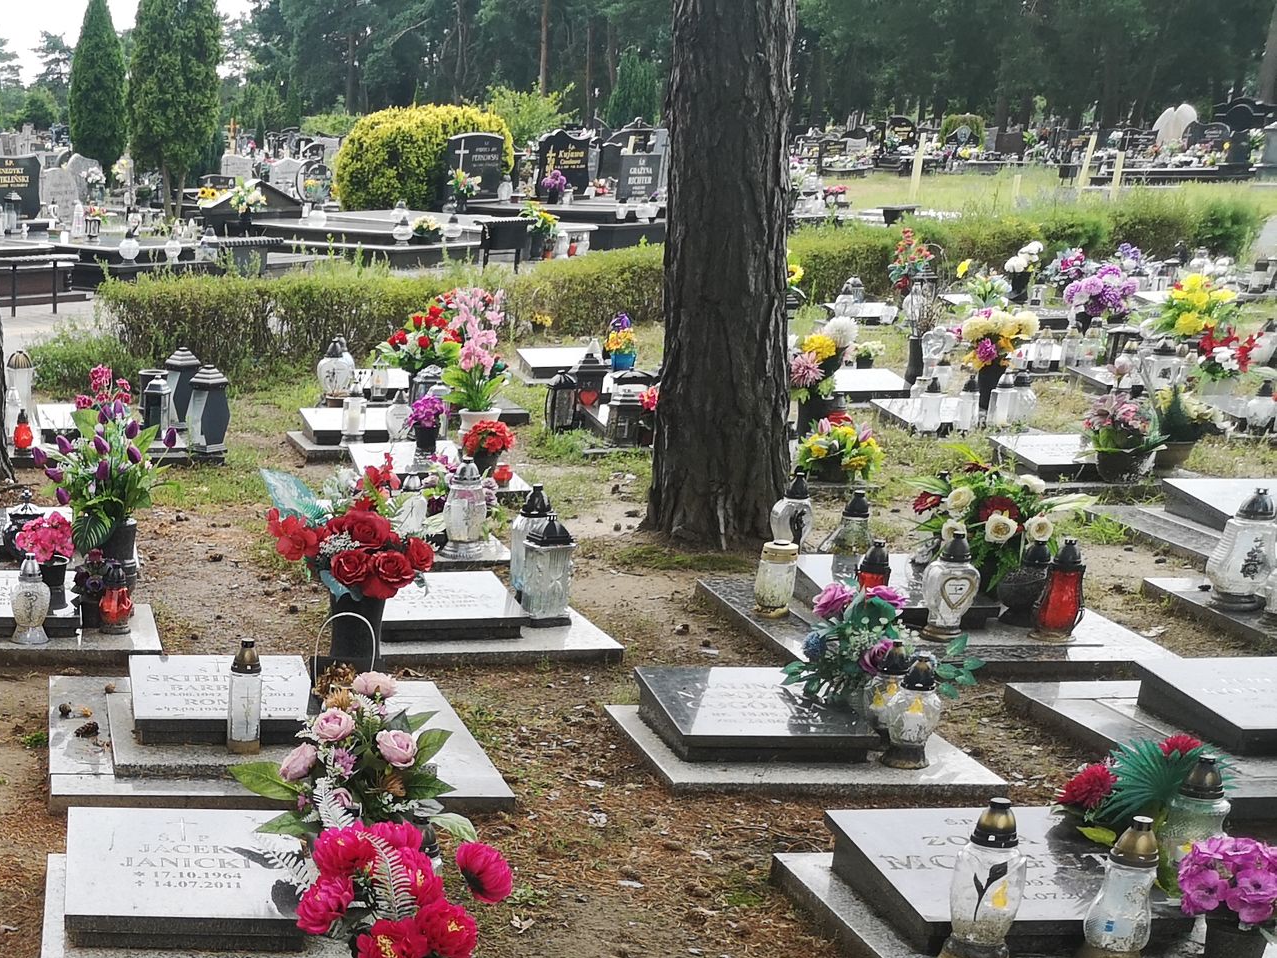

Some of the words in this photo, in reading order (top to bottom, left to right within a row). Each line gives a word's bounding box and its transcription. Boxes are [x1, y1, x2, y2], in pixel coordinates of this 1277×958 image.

[138, 844, 232, 854] JACEK
[119, 856, 251, 868] JANICKI
[153, 871, 242, 879] 17.10.1964
[153, 881, 242, 889] 14.07.2011
